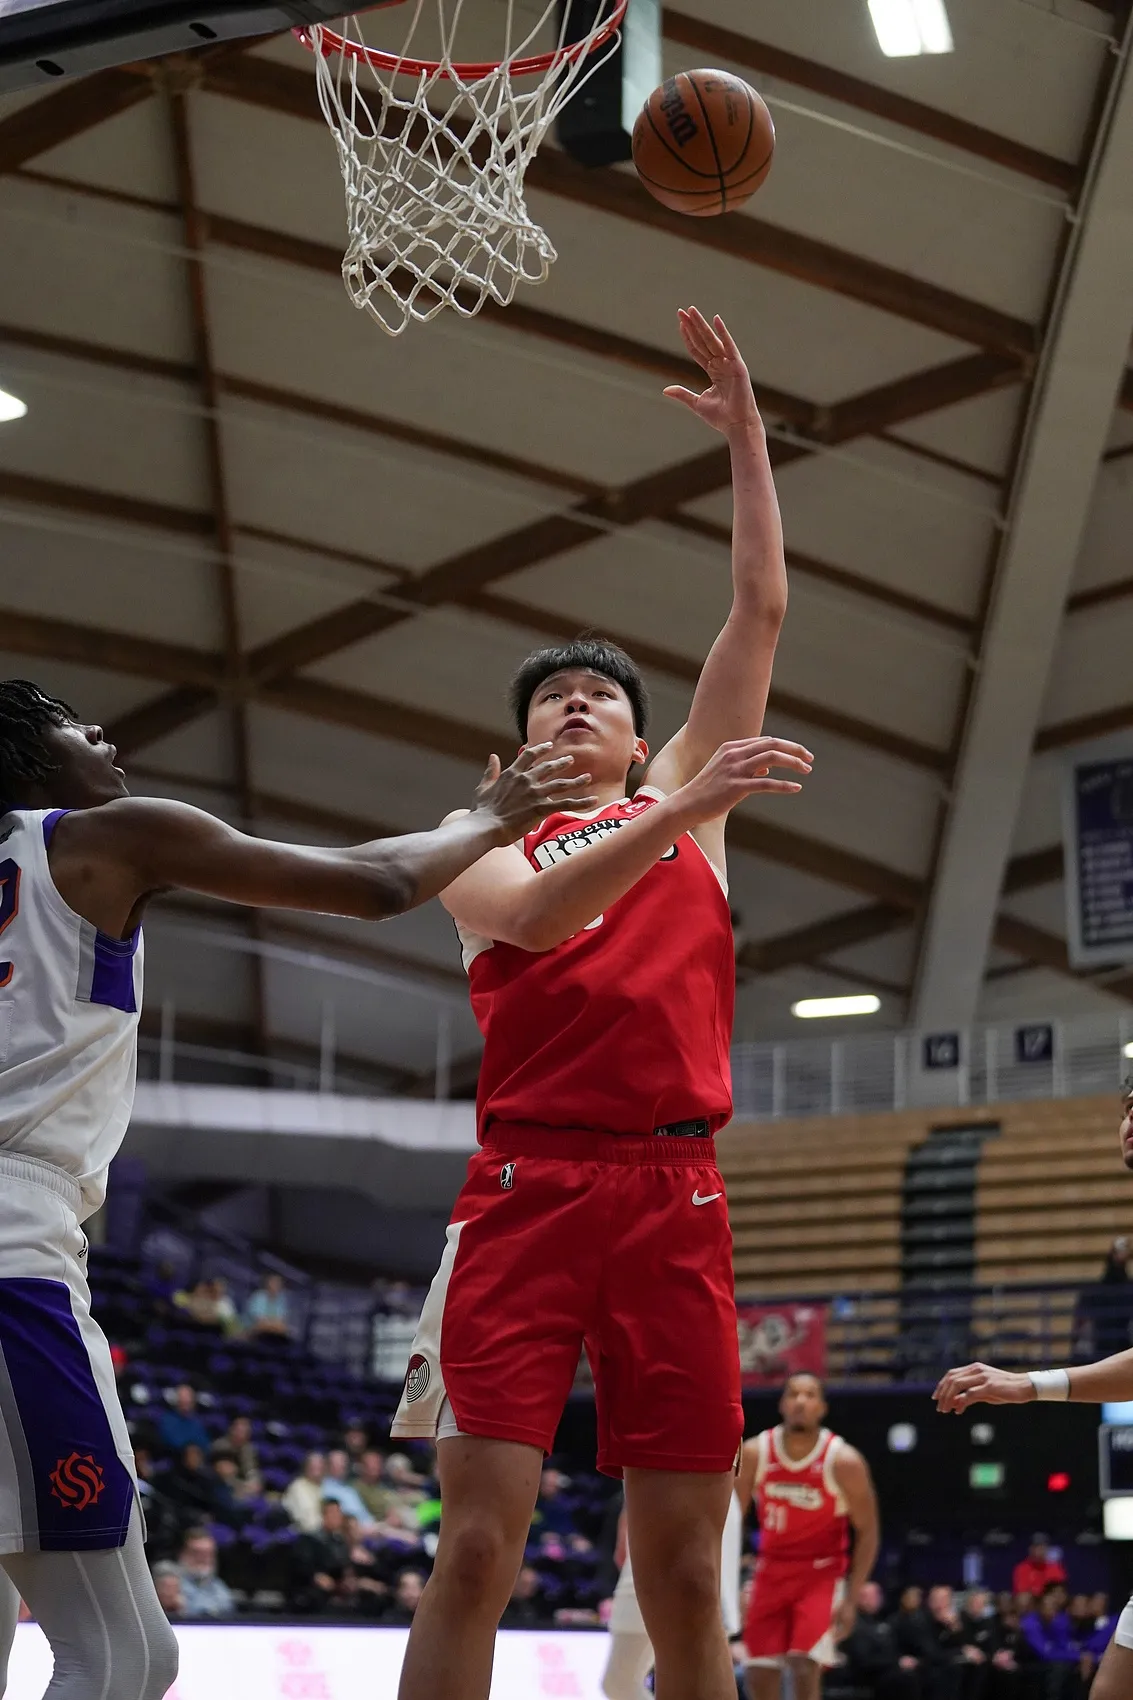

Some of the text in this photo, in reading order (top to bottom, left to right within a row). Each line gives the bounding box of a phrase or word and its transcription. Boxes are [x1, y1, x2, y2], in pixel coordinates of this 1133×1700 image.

[660, 76, 697, 147] Wil
[557, 819, 615, 841] RIP CITY
